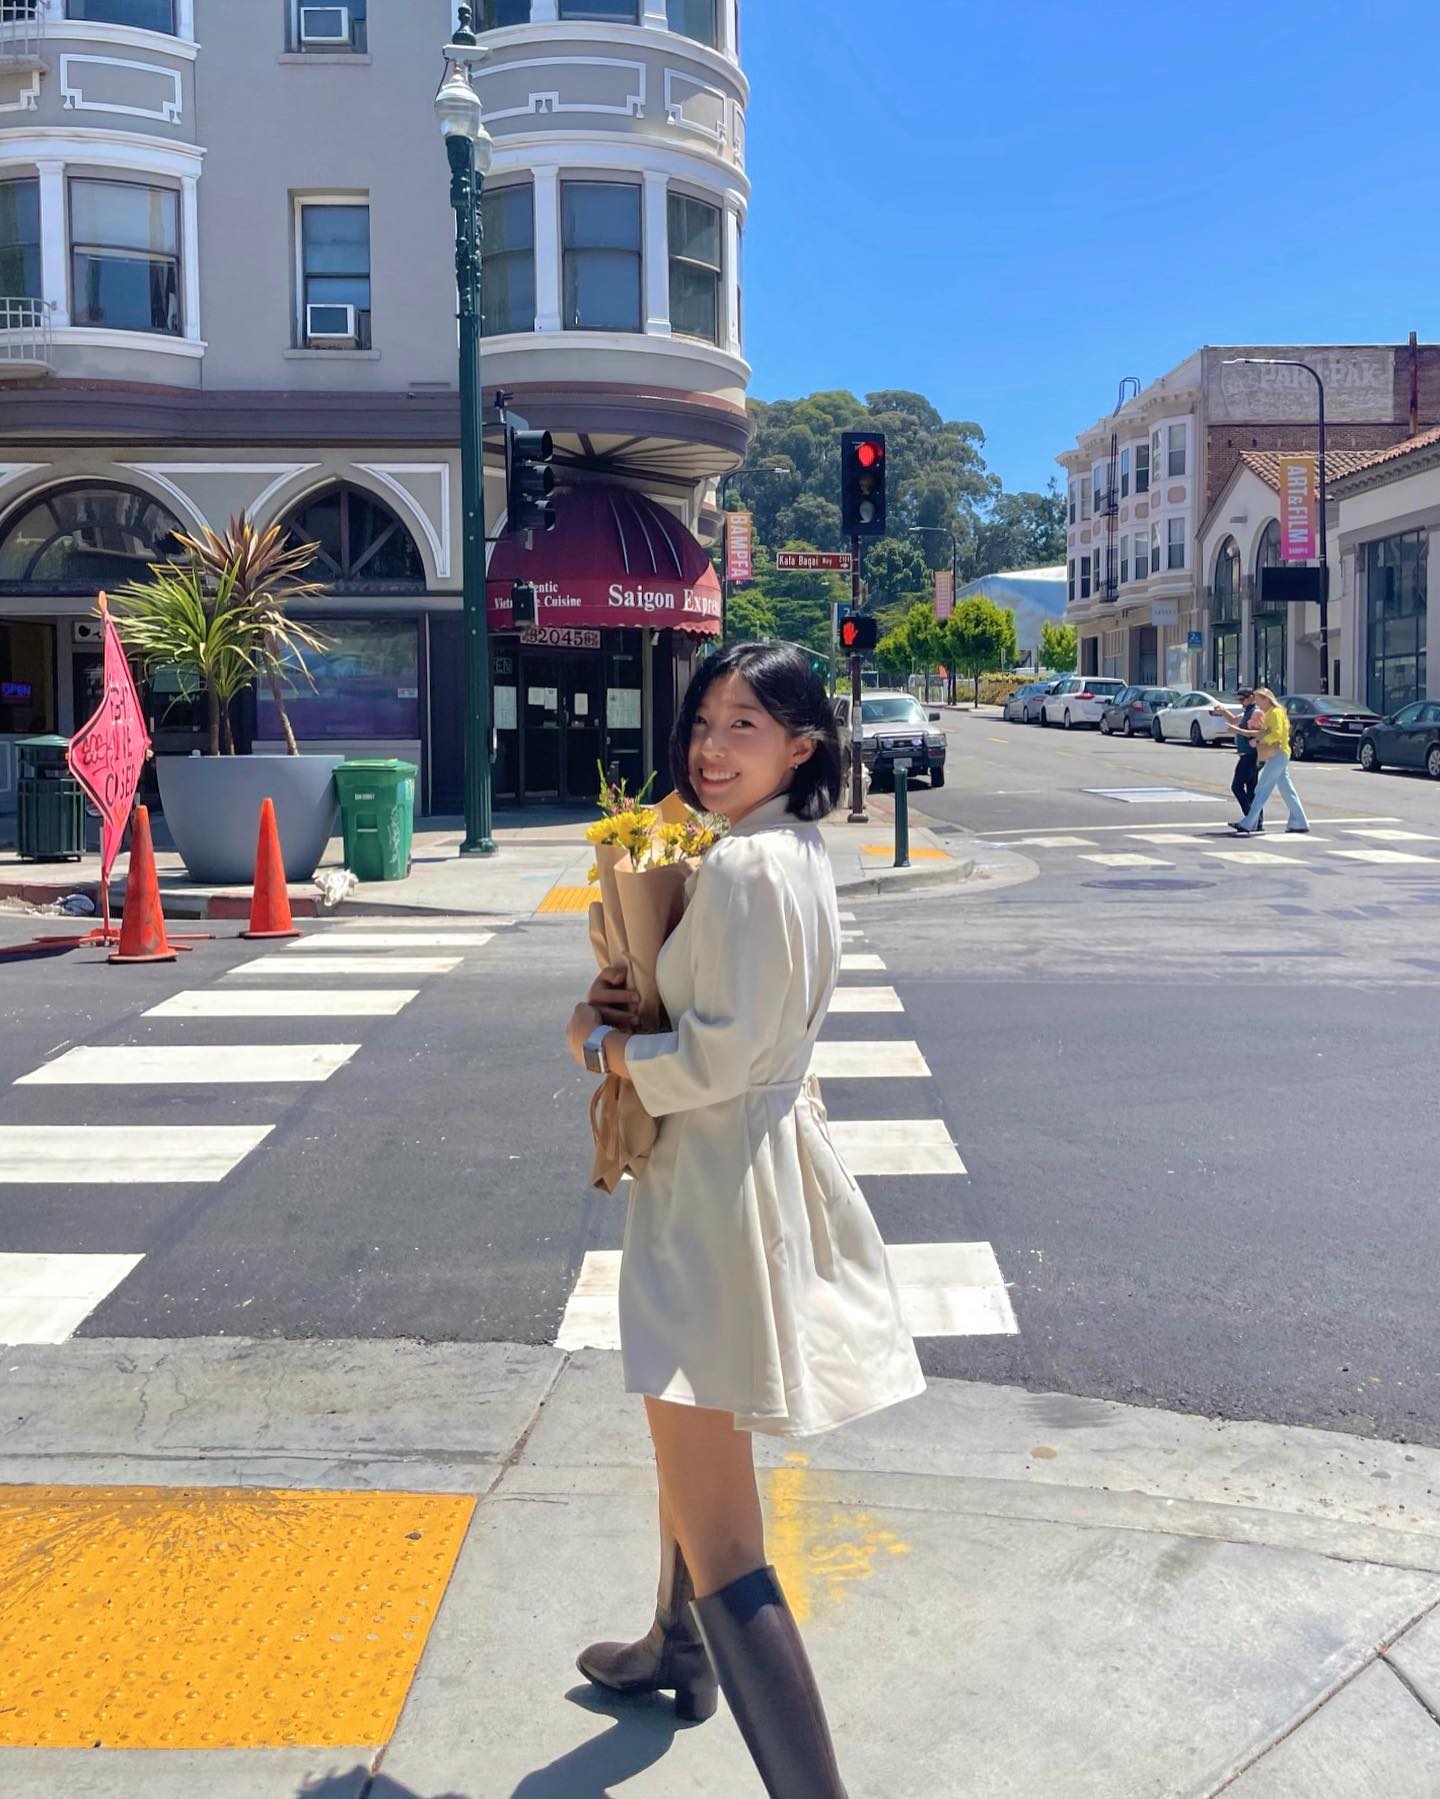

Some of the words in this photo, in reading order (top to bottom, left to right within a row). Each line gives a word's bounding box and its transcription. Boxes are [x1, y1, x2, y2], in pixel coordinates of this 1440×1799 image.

[730, 515, 749, 578] BAMPFA
[779, 555, 796, 566] Kala
[543, 594, 582, 608] Cuisine
[608, 583, 675, 612] Saigon
[681, 588, 721, 617] Expre
